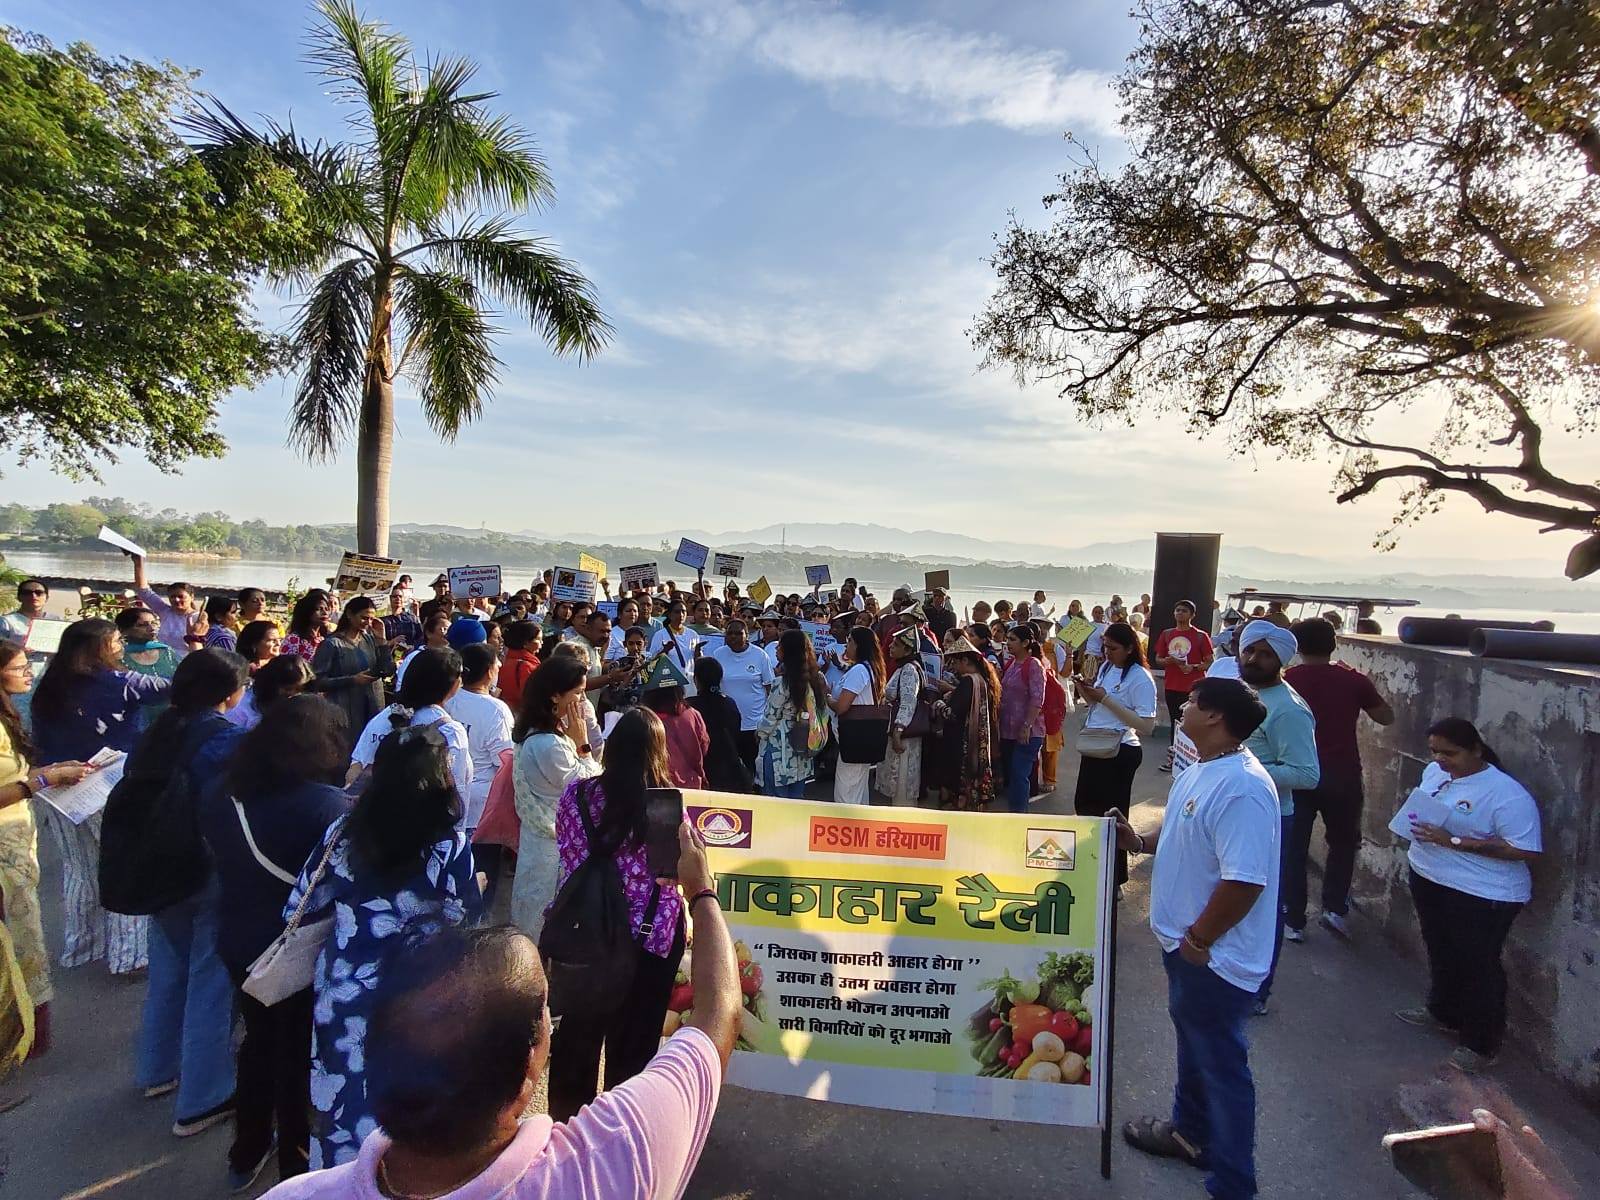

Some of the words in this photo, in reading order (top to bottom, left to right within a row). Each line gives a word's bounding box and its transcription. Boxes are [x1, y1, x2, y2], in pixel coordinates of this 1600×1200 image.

[813, 824, 870, 848] PSSM
[875, 828, 943, 851] हरियाणा
[1027, 858, 1054, 867] PMC
[714, 872, 943, 926] ाकाहार
[955, 873, 1075, 936] रैली
[767, 944, 817, 963] जिसका
[821, 952, 883, 968] शाकाहारी
[887, 955, 928, 970] आहार
[932, 955, 963, 971] होगा
[776, 970, 816, 985] उसका
[820, 972, 833, 988] ही
[838, 976, 869, 991] उत्तम
[873, 979, 921, 994] व्यवहार
[925, 979, 957, 996] होगा
[780, 994, 842, 1011] शाकाहारी
[846, 998, 888, 1016] भोजन
[890, 1004, 951, 1020] अपनाओ
[778, 1017, 805, 1031] सारी
[809, 1018, 866, 1037] बिमारियों
[868, 1024, 886, 1039] को
[890, 1027, 907, 1045] दूर
[909, 1029, 952, 1045] भगाओ
